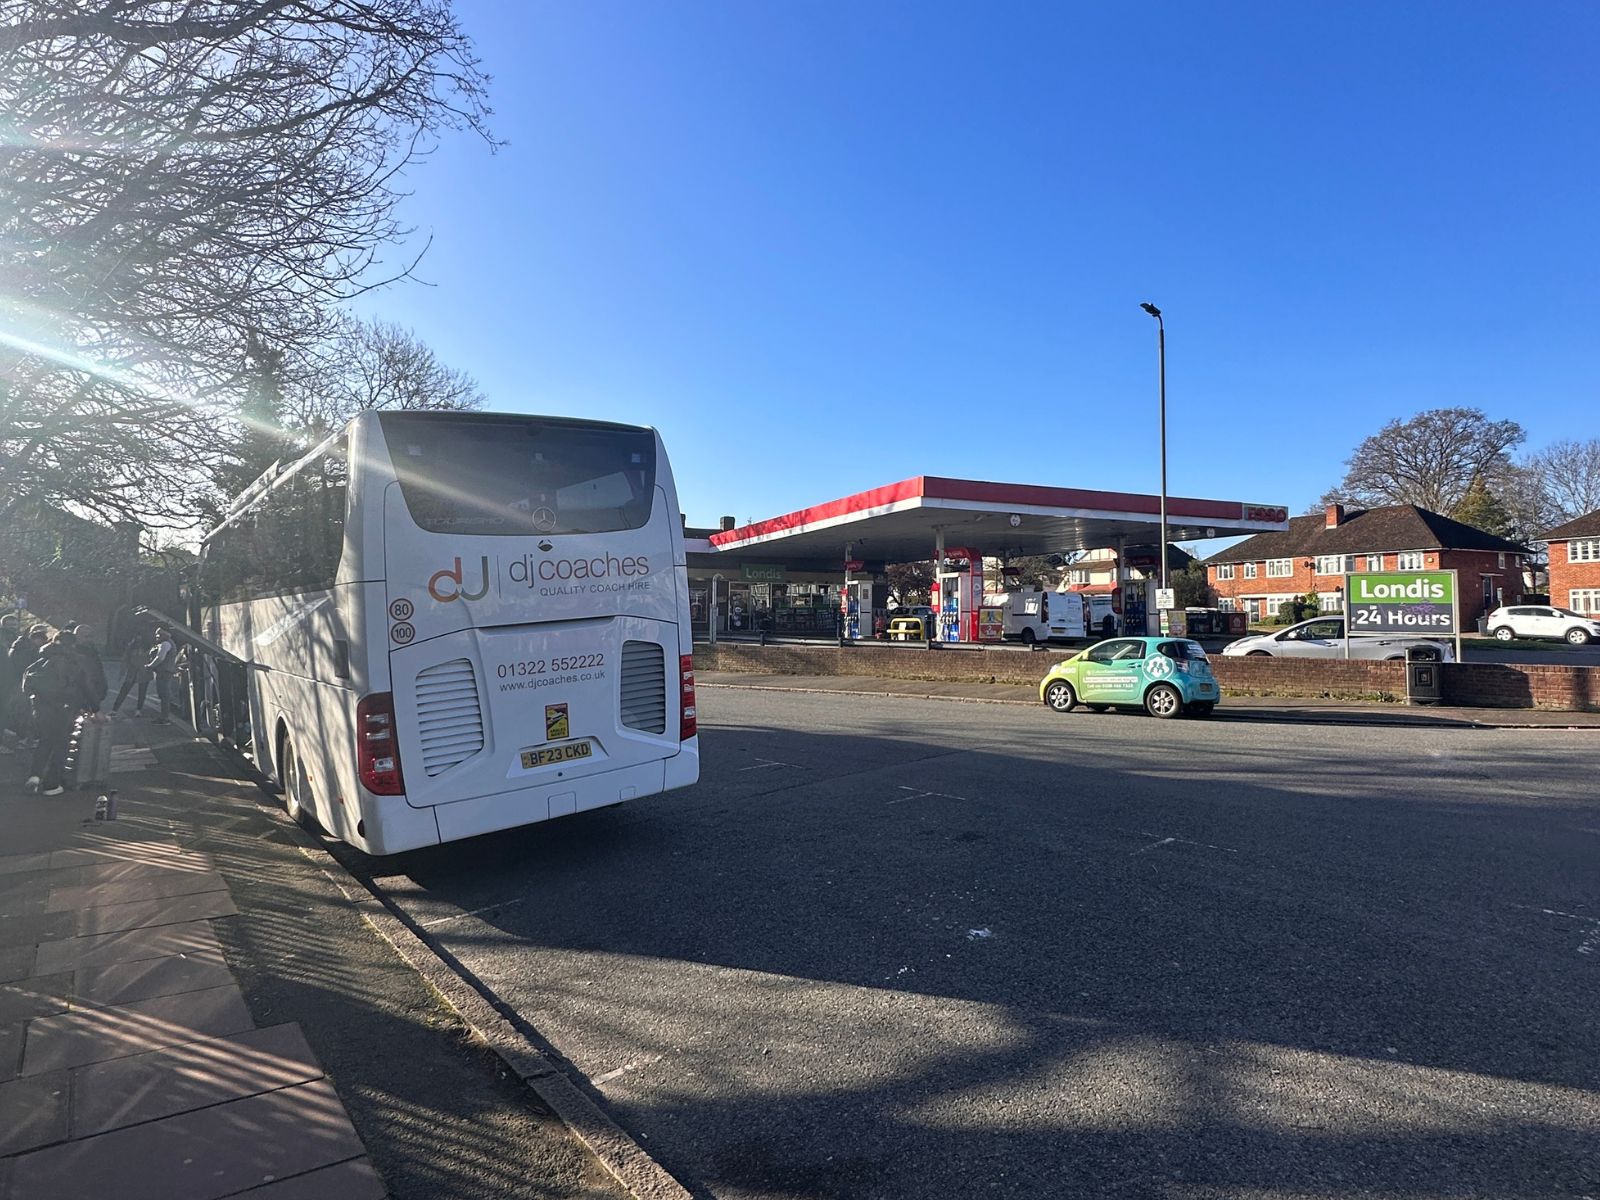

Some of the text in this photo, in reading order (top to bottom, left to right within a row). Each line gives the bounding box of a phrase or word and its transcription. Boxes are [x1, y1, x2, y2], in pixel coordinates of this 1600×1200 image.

[745, 568, 782, 579] Londis
[540, 581, 650, 597] QUALITY COACH HIRE
[1361, 578, 1445, 598] Londis
[394, 603, 409, 616] 80
[1356, 609, 1451, 626] 24 Hours
[394, 627, 411, 639] 100
[497, 653, 604, 678] 01322 552222
[499, 670, 606, 692] www.djcoaches.co.uk
[530, 743, 589, 765] BF23 CKD
